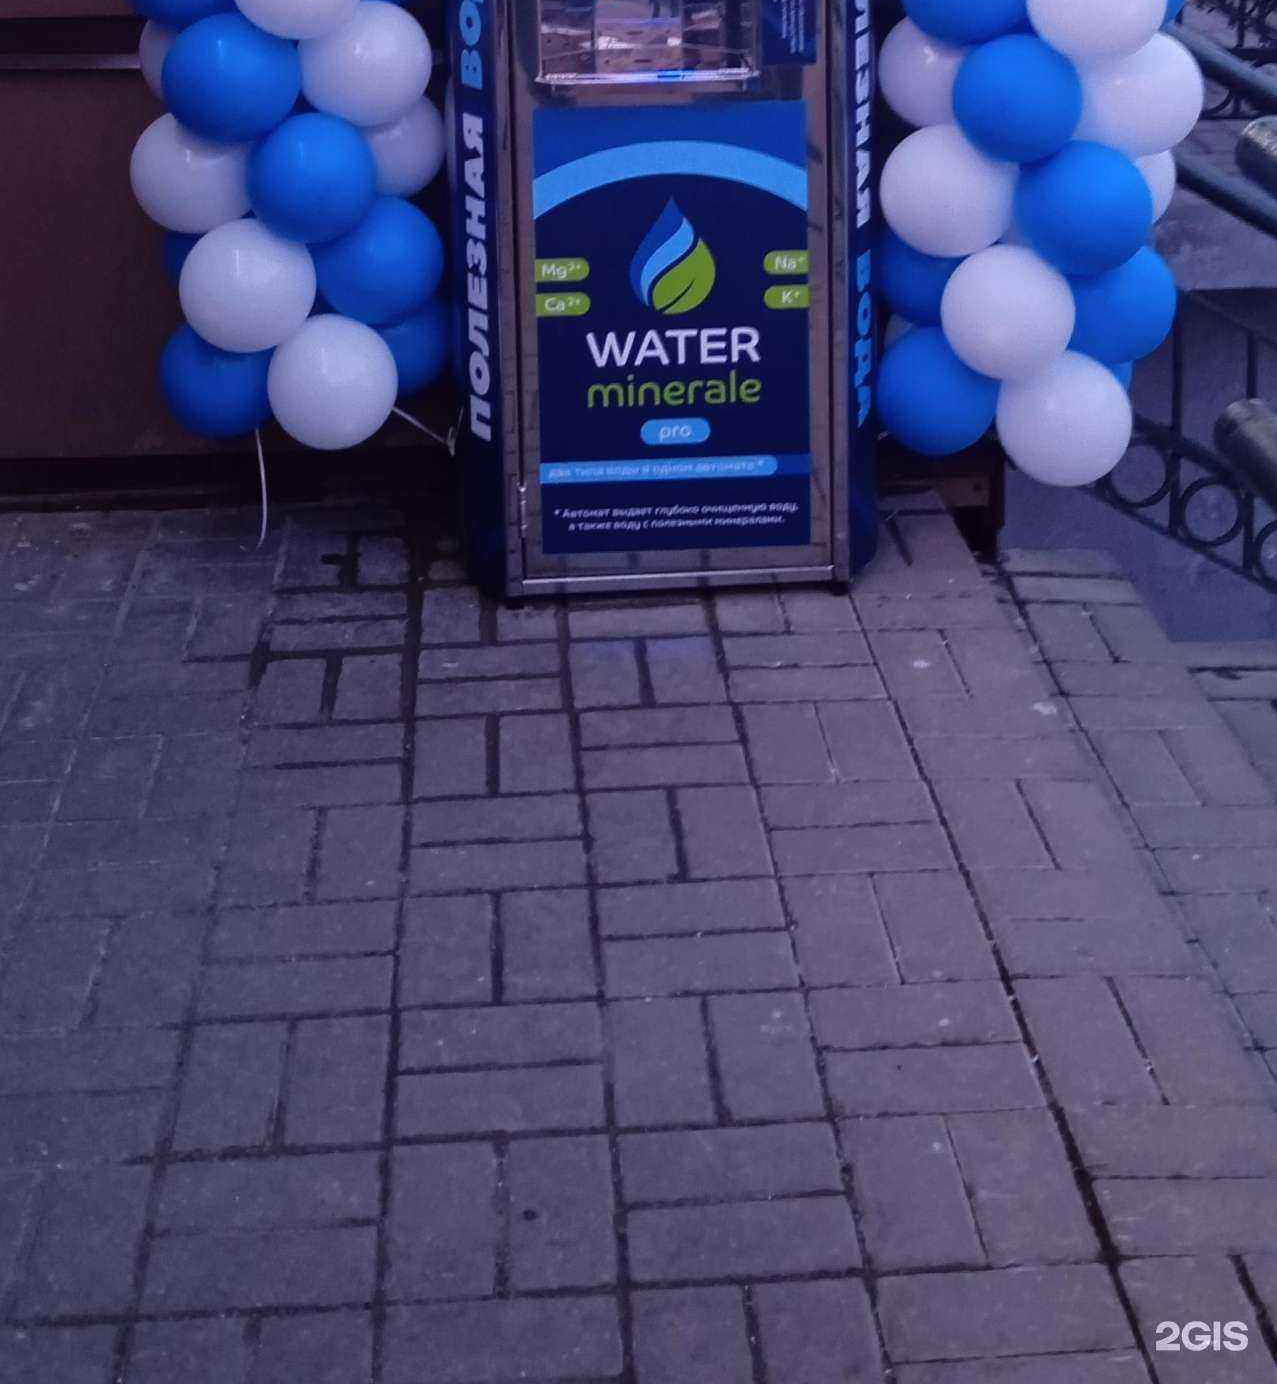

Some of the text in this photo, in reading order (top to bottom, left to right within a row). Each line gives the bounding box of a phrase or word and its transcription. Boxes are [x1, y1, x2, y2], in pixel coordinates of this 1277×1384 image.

[461, 112, 492, 442] ПОЛЕЗНАЯ
[586, 327, 761, 367] WATER
[587, 370, 762, 408] minerale
[660, 423, 693, 442] pro
